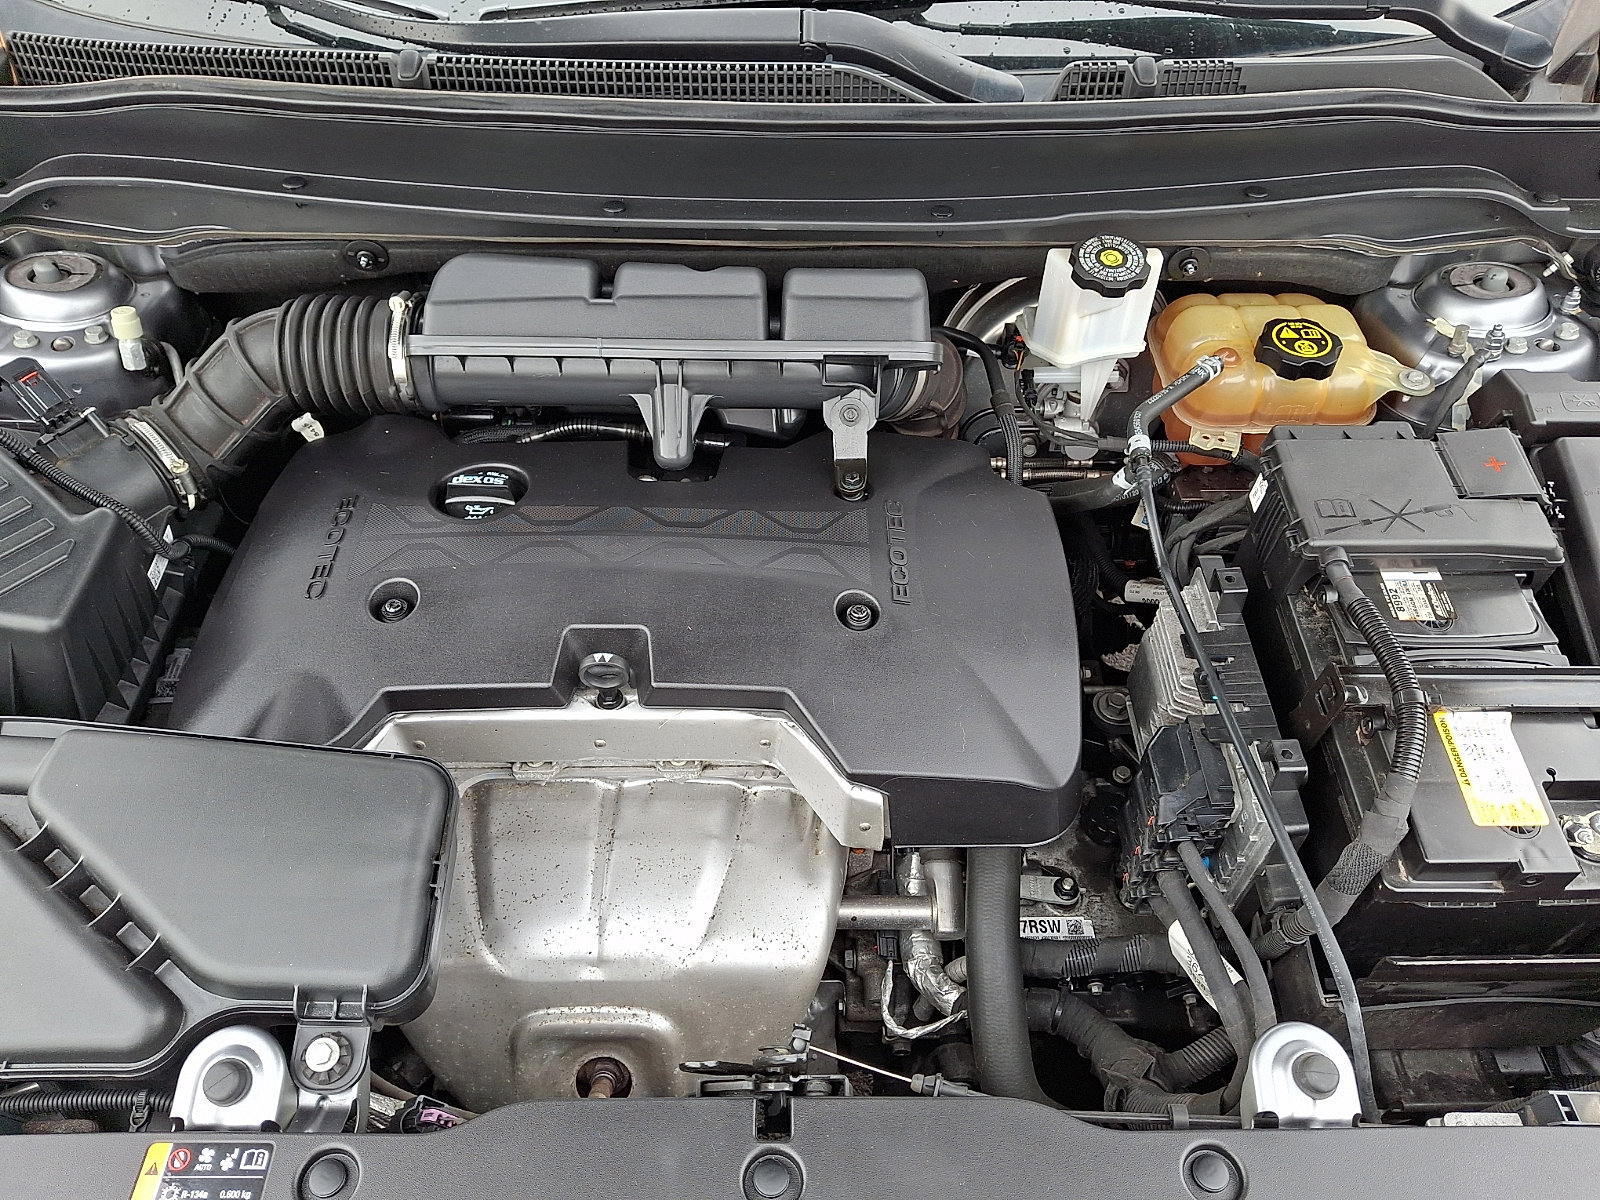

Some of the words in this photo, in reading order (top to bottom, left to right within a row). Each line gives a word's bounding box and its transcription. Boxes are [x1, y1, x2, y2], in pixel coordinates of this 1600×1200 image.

[452, 474, 506, 485] dexos
[305, 495, 359, 600] ECOTEC
[884, 500, 911, 605] ECOTEC
[1388, 587, 1405, 612] 8992
[1439, 717, 1471, 778] DANGER/POISON
[1020, 919, 1060, 934] 7RSW
[194, 1163, 213, 1171] AUTO
[241, 1189, 252, 1200] kg
